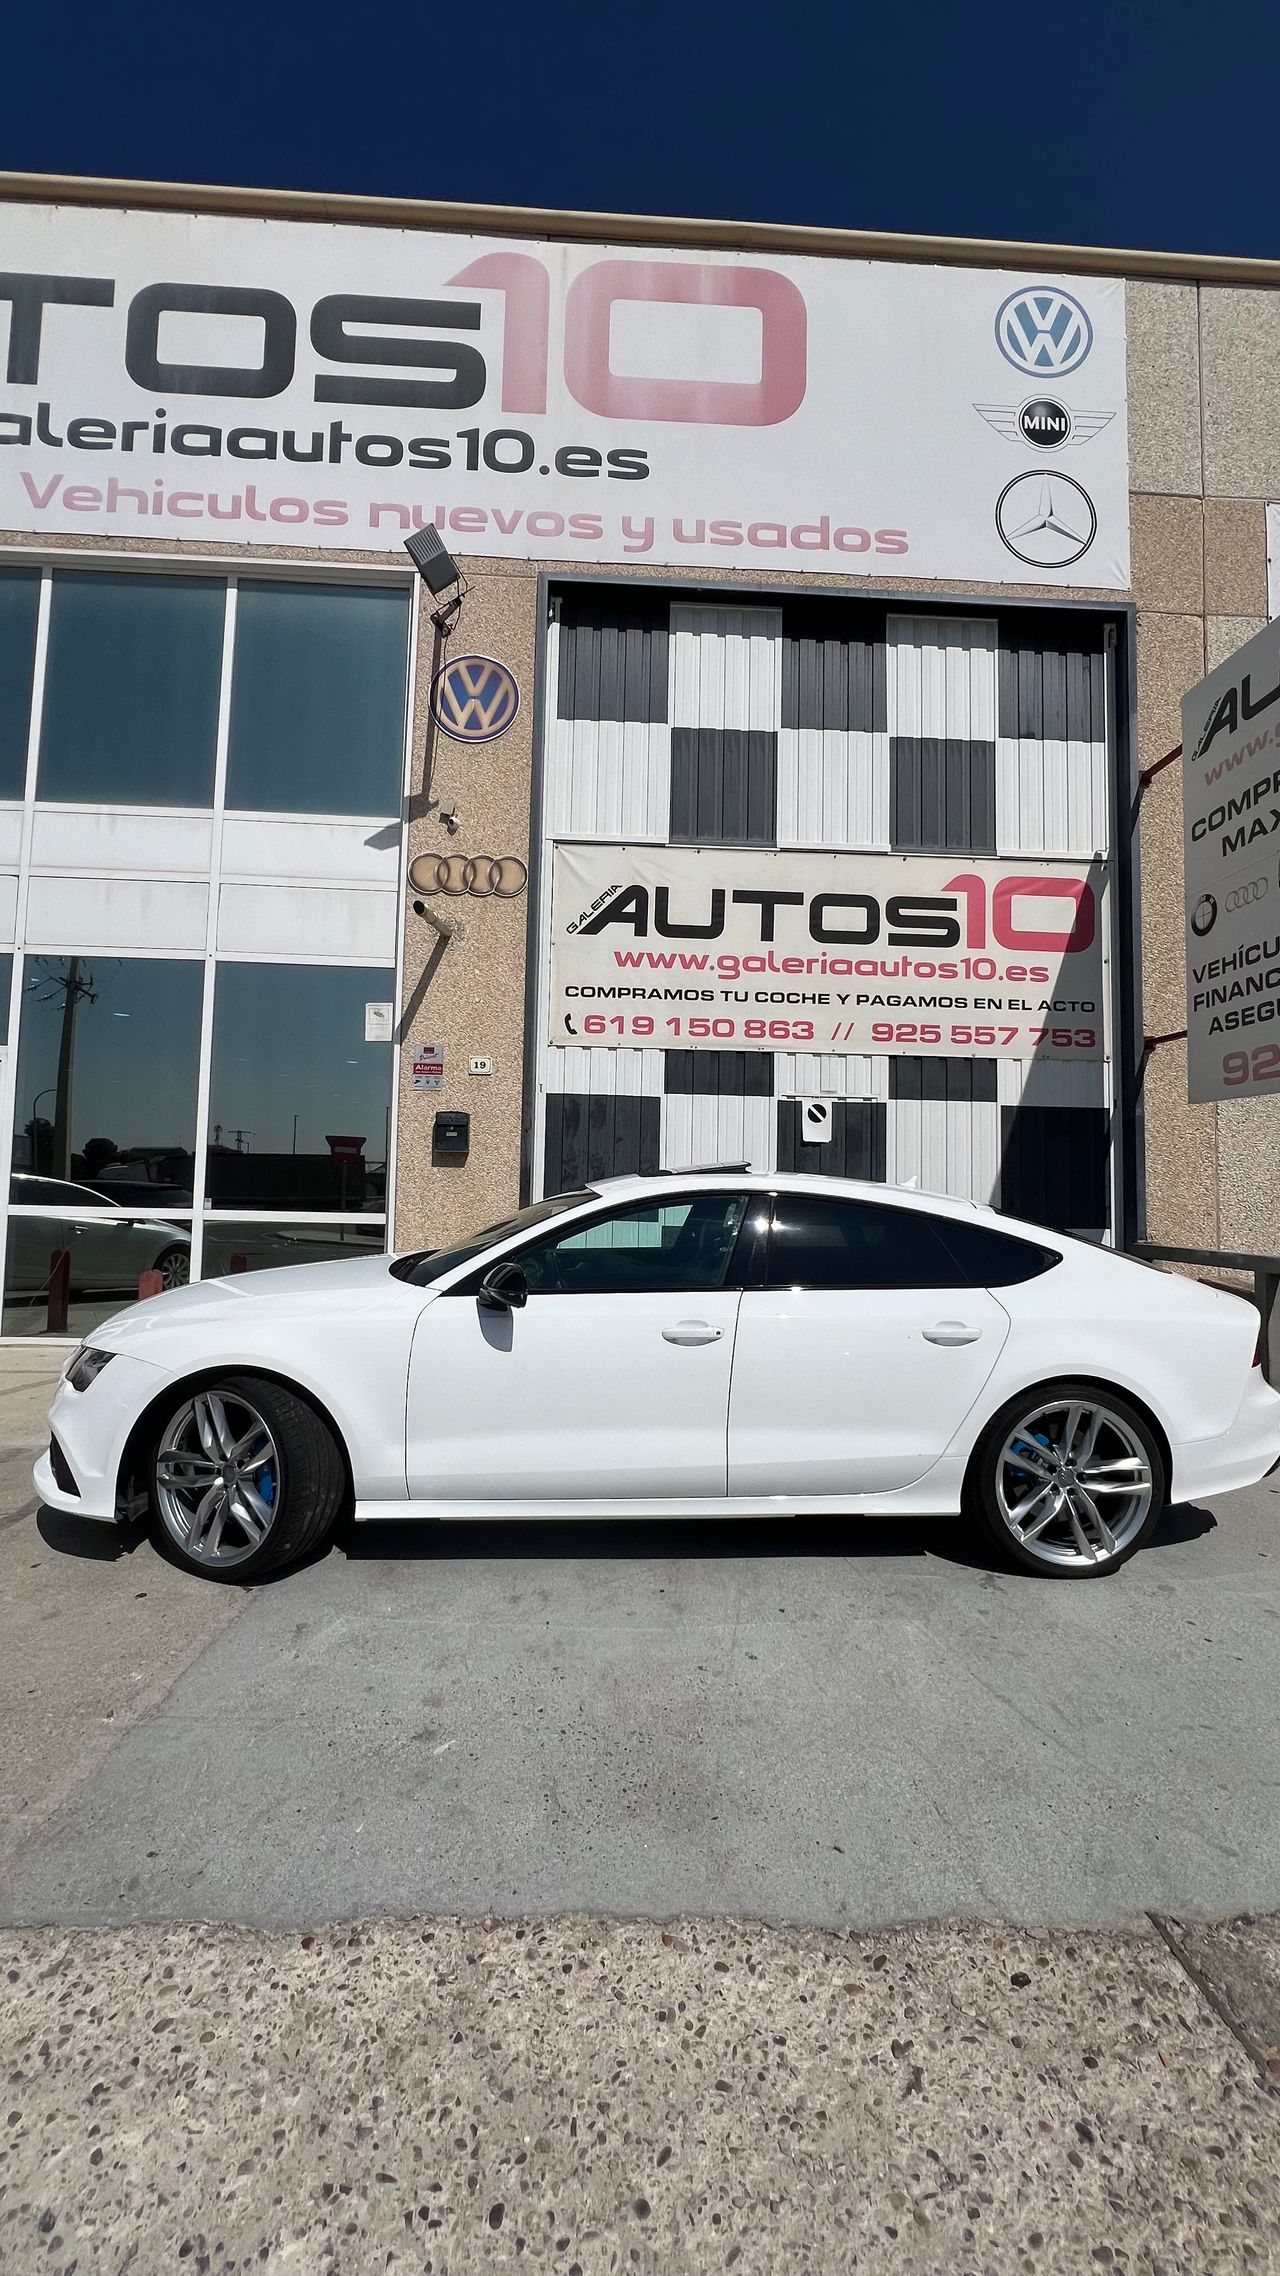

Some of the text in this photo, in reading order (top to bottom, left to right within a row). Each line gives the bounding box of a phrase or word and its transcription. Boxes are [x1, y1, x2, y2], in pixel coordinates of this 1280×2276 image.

[1024, 415, 1066, 431] MINI
[20, 471, 909, 555] Vehiculos nuevos y usados
[566, 884, 623, 934] GALERIA
[576, 873, 1095, 954] AUTOS10
[614, 951, 1049, 982] www.galeriaautos10.es
[565, 986, 1096, 1013] COMPRAMOS TU COCHE Y PAGAMOS EN EL ACTO
[1194, 967, 1280, 1012] FINANC
[583, 1014, 655, 1036] 619
[666, 1017, 735, 1038] 150
[744, 1019, 814, 1040] 863
[871, 1023, 942, 1043] 925
[950, 1026, 1019, 1046] 557
[1029, 1027, 1096, 1048] 753
[1208, 998, 1280, 1035] ASEG
[473, 1061, 487, 1070] 19
[1222, 1044, 1280, 1086] 92
